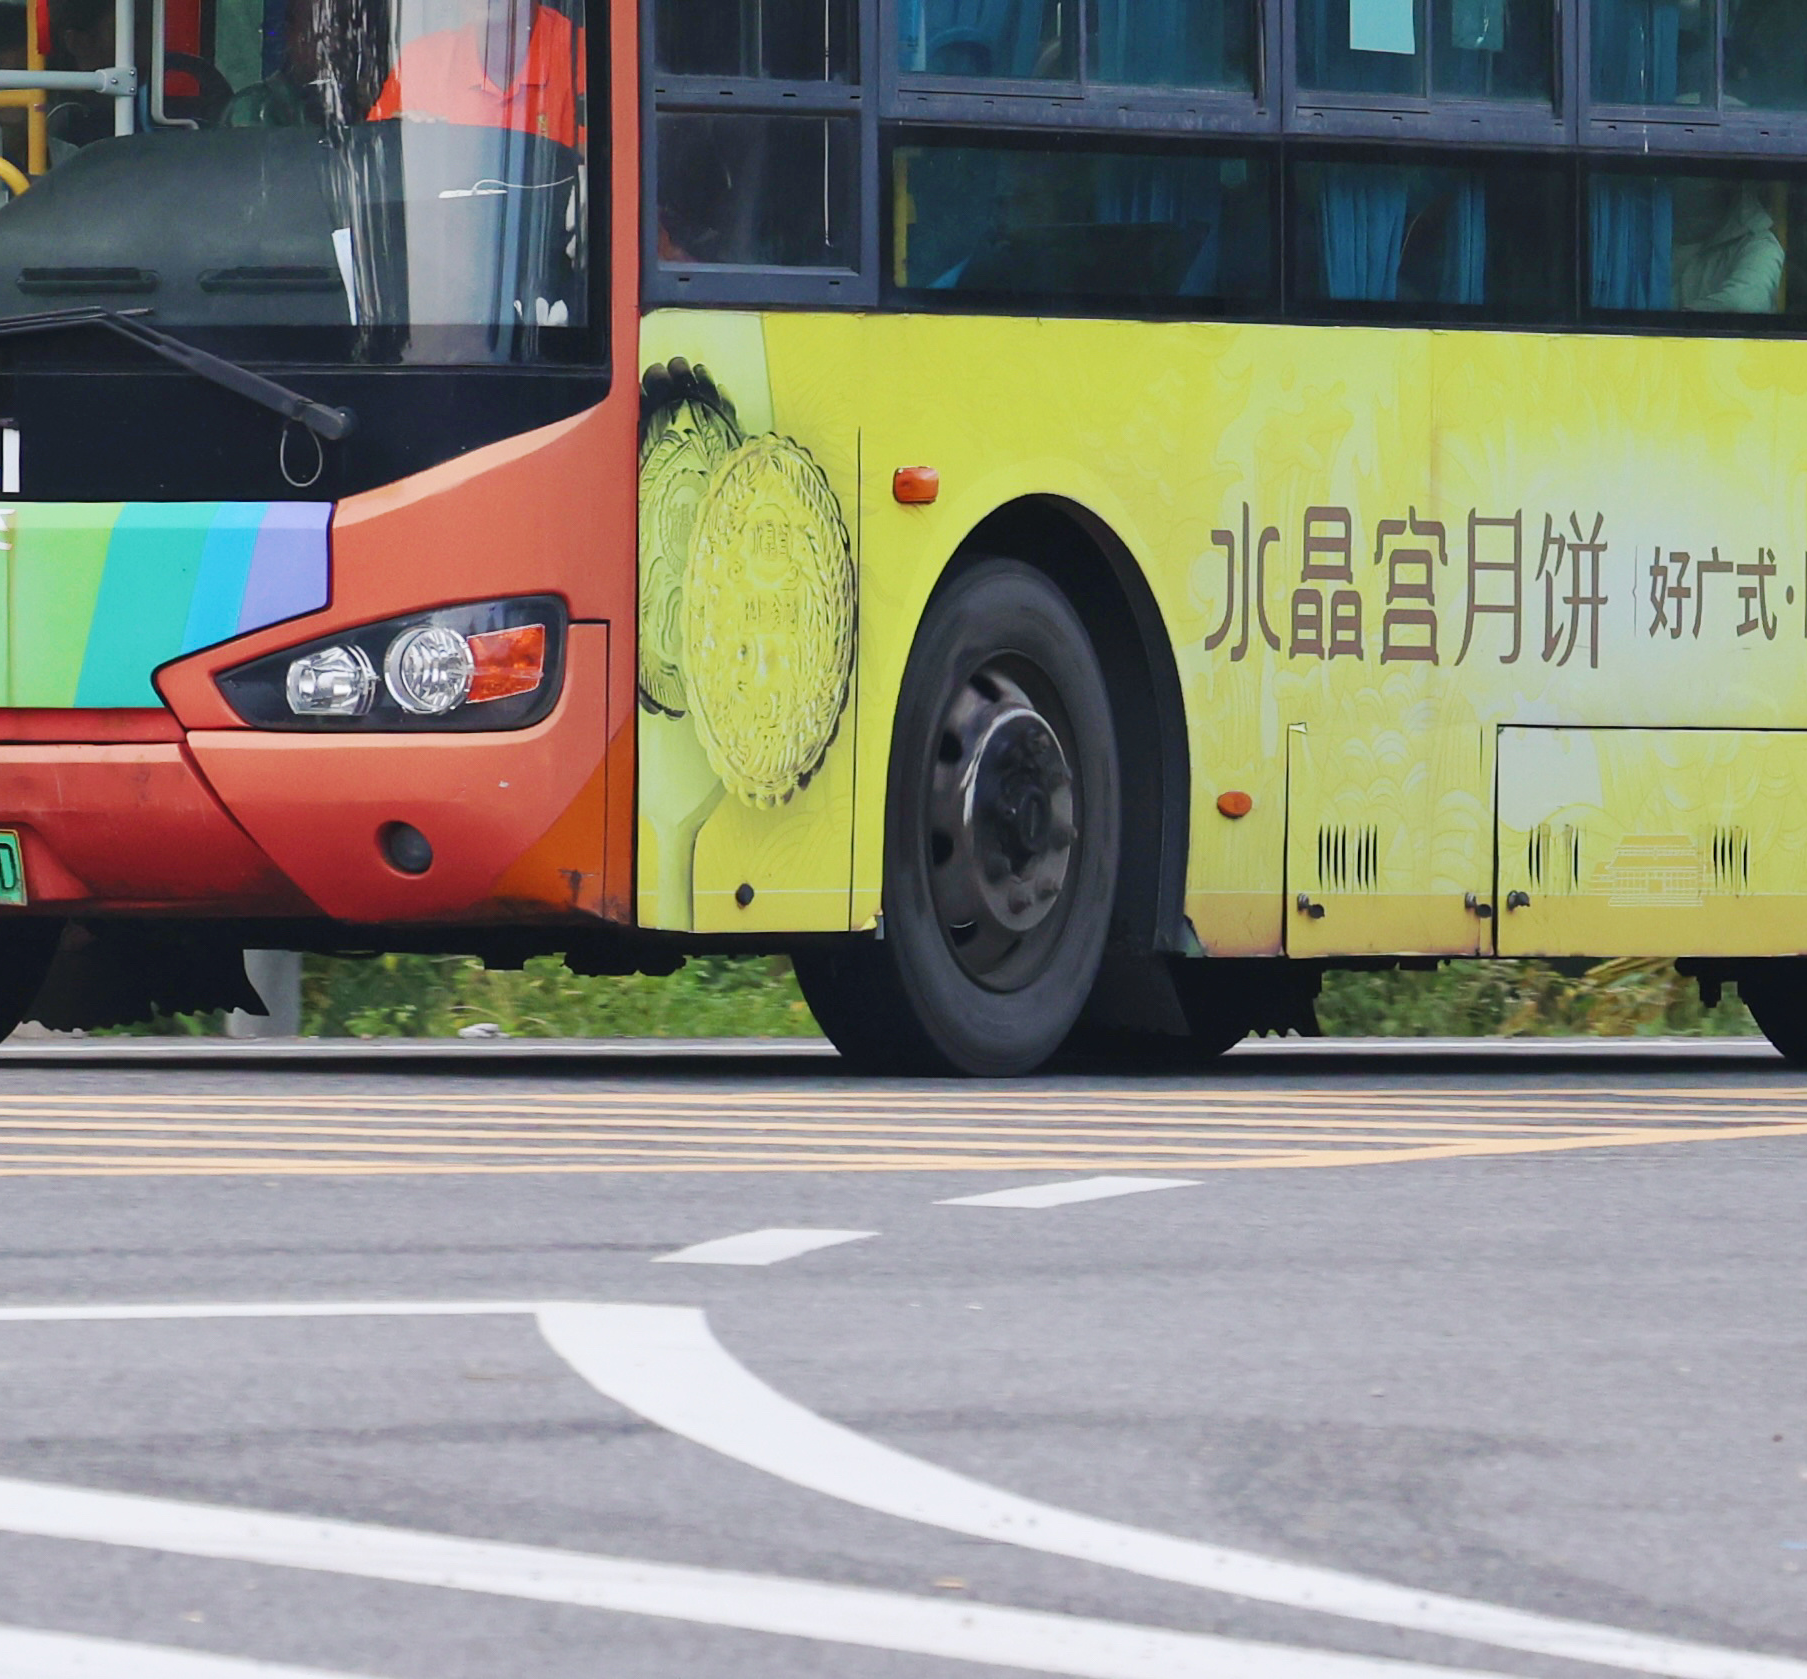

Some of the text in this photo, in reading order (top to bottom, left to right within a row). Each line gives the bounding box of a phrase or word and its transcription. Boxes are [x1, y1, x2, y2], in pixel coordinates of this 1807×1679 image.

[1204, 500, 1609, 669] 水晶宫月饼
